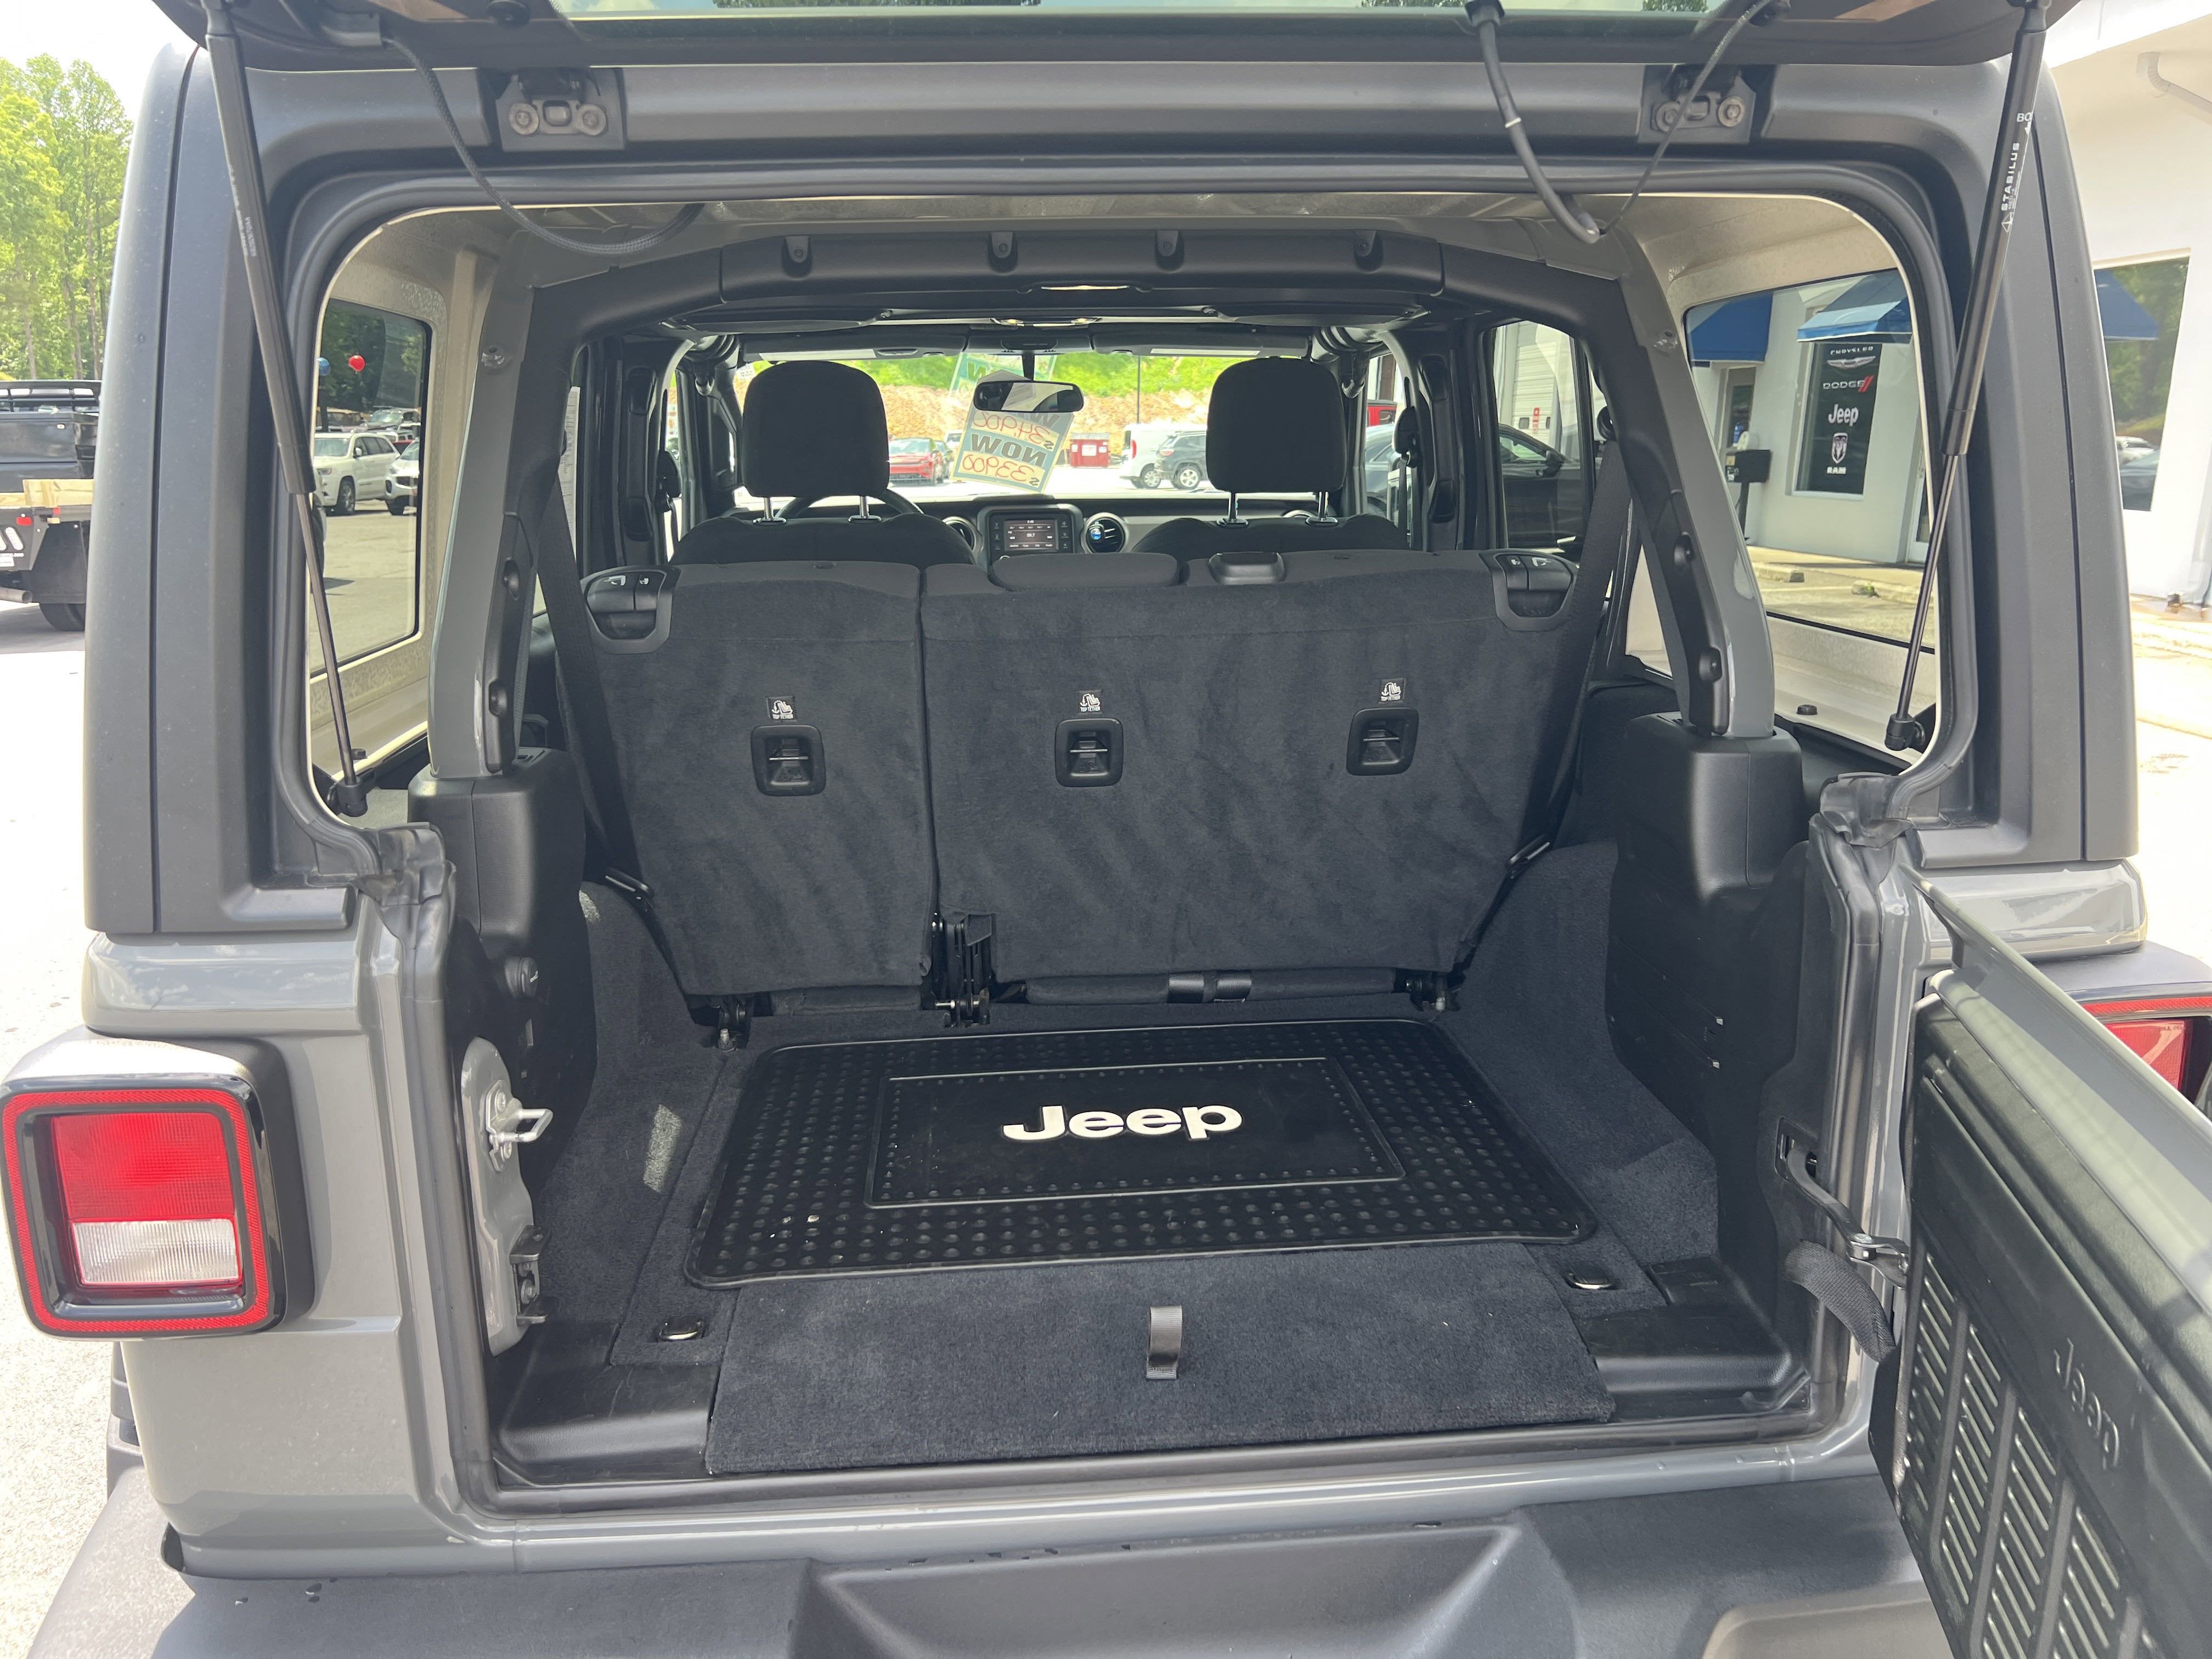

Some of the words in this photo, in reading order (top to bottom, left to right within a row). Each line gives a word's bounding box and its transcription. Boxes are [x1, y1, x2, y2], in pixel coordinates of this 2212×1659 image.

[2001, 143, 2020, 211] STABILUS
[1822, 380, 1865, 390] DODGE
[1828, 403, 1859, 427] Jeep
[1826, 466, 1847, 475] RAM
[1003, 1105, 1243, 1140] Jeep
[2053, 1337, 2120, 1471] Jeep
